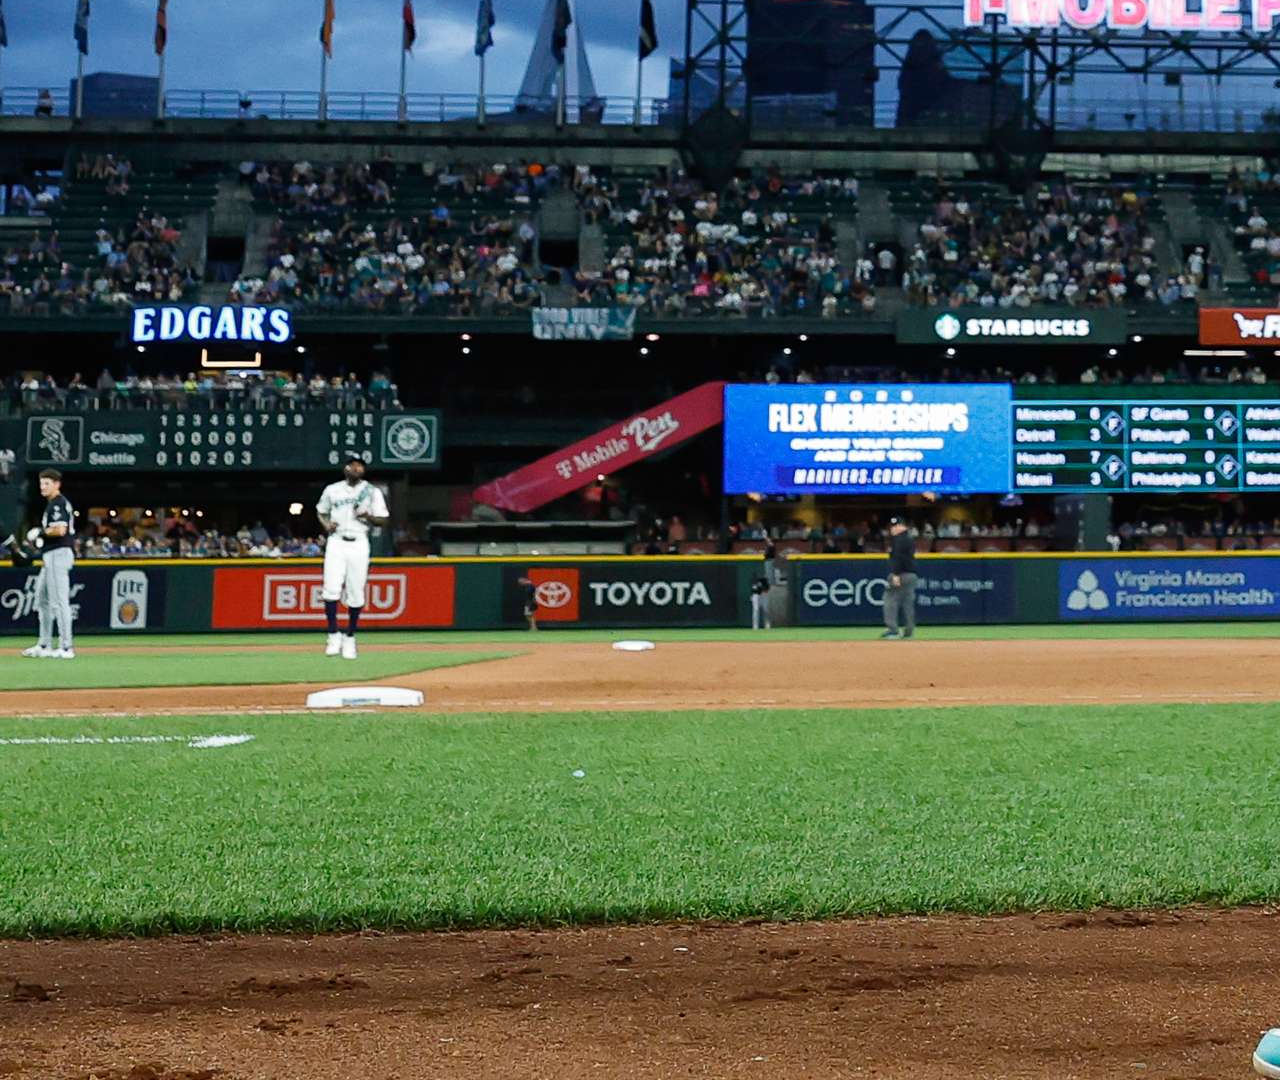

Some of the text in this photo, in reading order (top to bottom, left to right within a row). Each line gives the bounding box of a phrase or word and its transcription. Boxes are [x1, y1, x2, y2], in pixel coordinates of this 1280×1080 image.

[133, 306, 290, 342] EDGAR'S
[966, 319, 1090, 336] STARBUCKS
[768, 403, 969, 432] FLEX MEMBERSHIPS
[90, 431, 371, 446] Chicago 1 0 0 0 0 0 1 2 1
[89, 451, 136, 466] Seattle
[156, 451, 168, 466] 0
[176, 451, 183, 466] 1
[190, 451, 202, 466] 0
[207, 451, 218, 466] 2
[223, 451, 235, 466] 0
[241, 451, 252, 465] 3
[328, 450, 339, 465] 6
[574, 437, 630, 472] Mobile
[793, 466, 943, 485] MARINERS.COM/FLEX
[1115, 570, 1245, 591] Virginia Mason
[589, 581, 711, 606] TOYOTA
[1115, 590, 1211, 607] Franciscan
